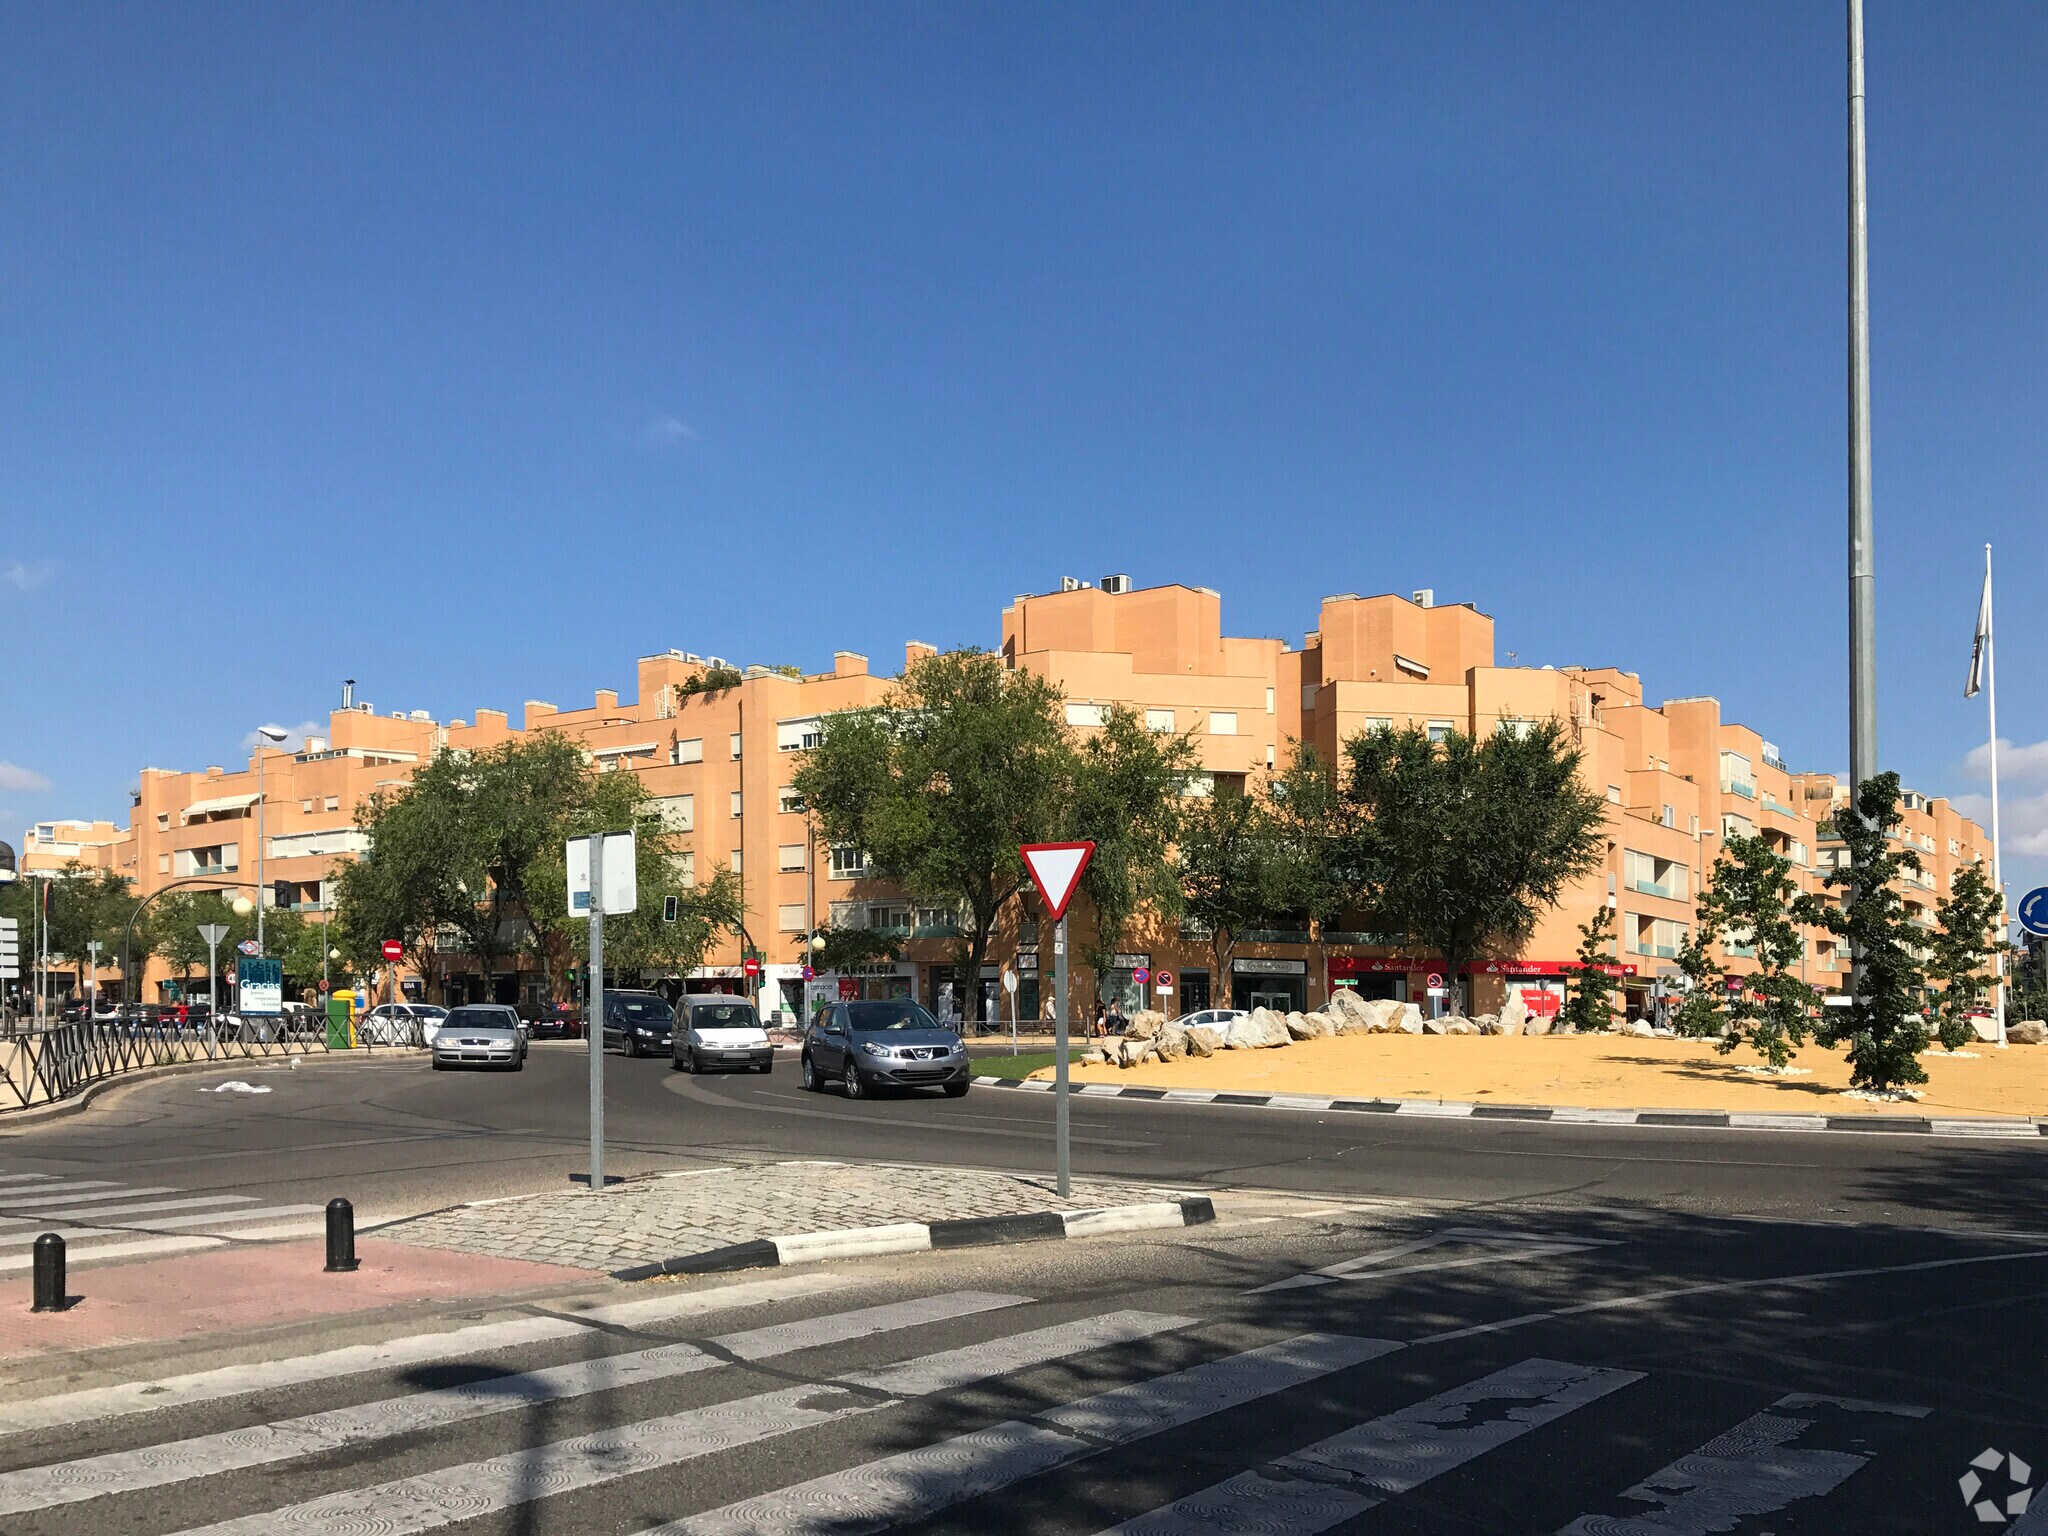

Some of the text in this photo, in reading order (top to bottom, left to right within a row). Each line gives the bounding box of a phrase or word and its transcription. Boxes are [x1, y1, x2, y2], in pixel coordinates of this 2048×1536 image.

[1385, 964, 1424, 972] Santander
[1500, 965, 1542, 973] Santander
[240, 979, 281, 990] Gracias
